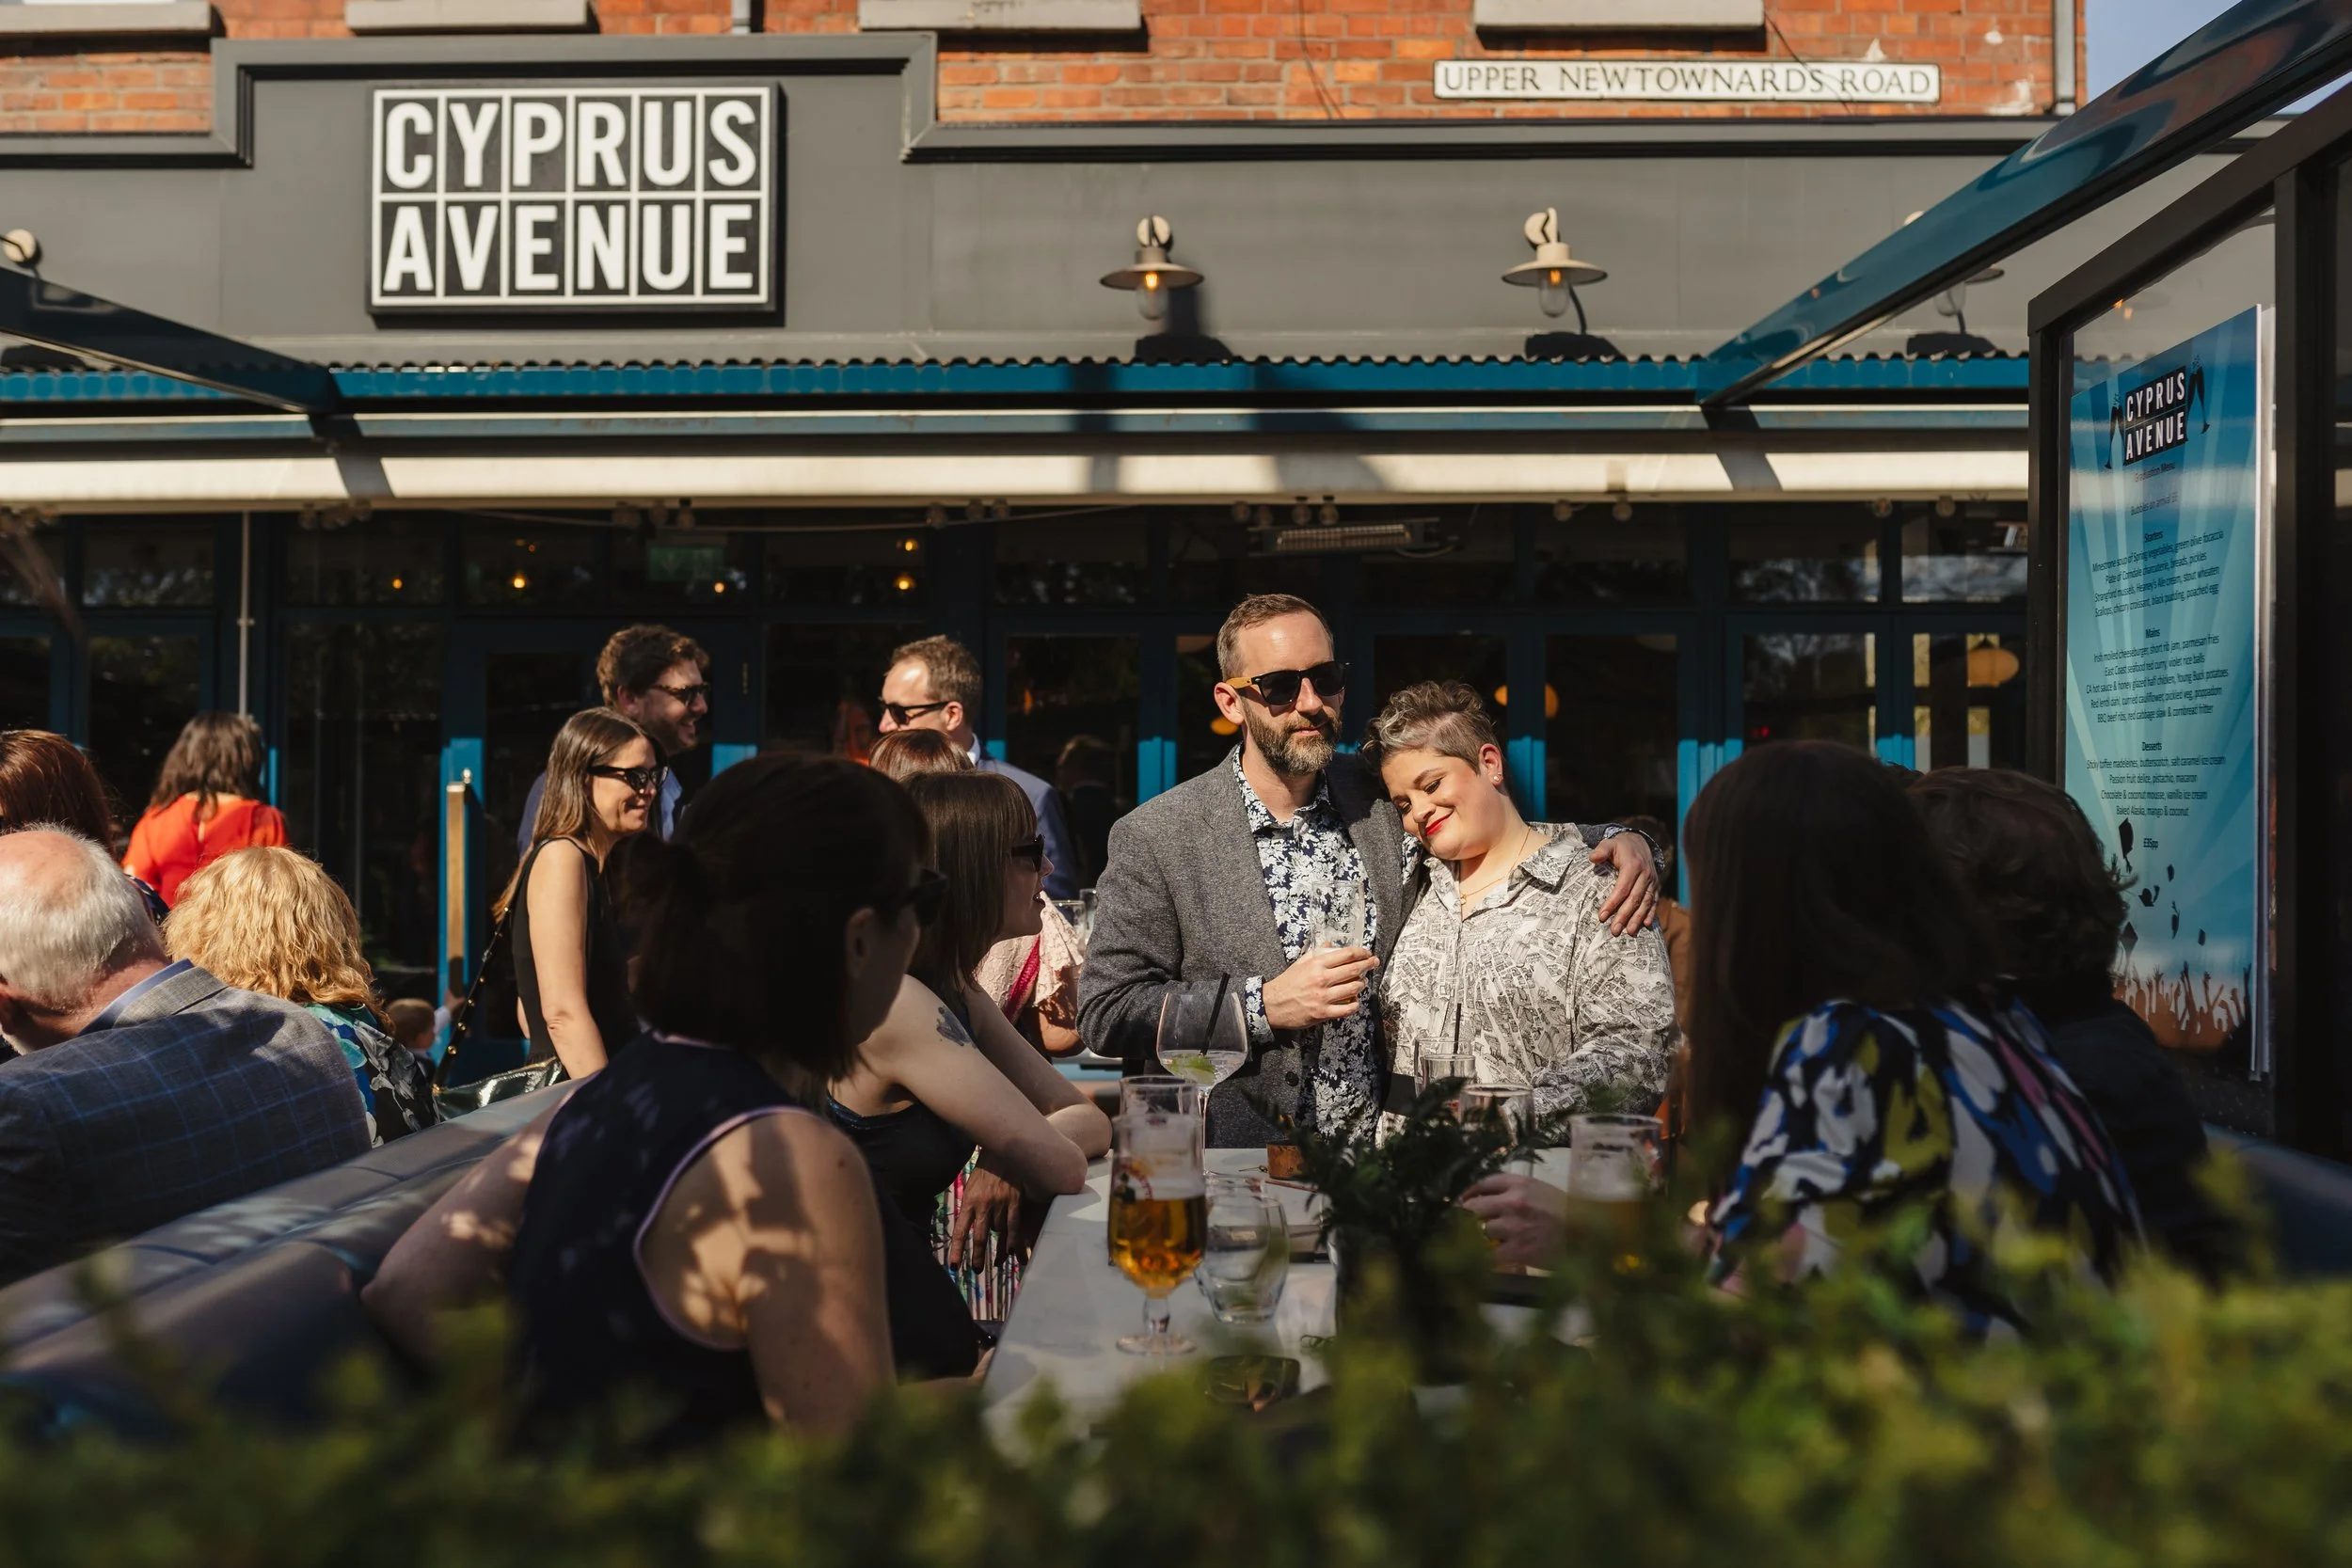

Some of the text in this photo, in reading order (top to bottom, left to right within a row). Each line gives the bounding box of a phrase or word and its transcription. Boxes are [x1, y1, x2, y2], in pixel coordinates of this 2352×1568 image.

[1443, 66, 1931, 94] UPPER NEWTOWNARDS ROAD
[385, 100, 756, 189] CYPRUS
[382, 204, 753, 291] AVENUE
[2126, 372, 2185, 422] CYPRUS
[2125, 411, 2185, 460] AVENUE
[2145, 627, 2160, 638] Mains
[2114, 664, 2127, 674] Coast
[2141, 741, 2162, 751] Desserts
[2115, 805, 2130, 815] Baked
